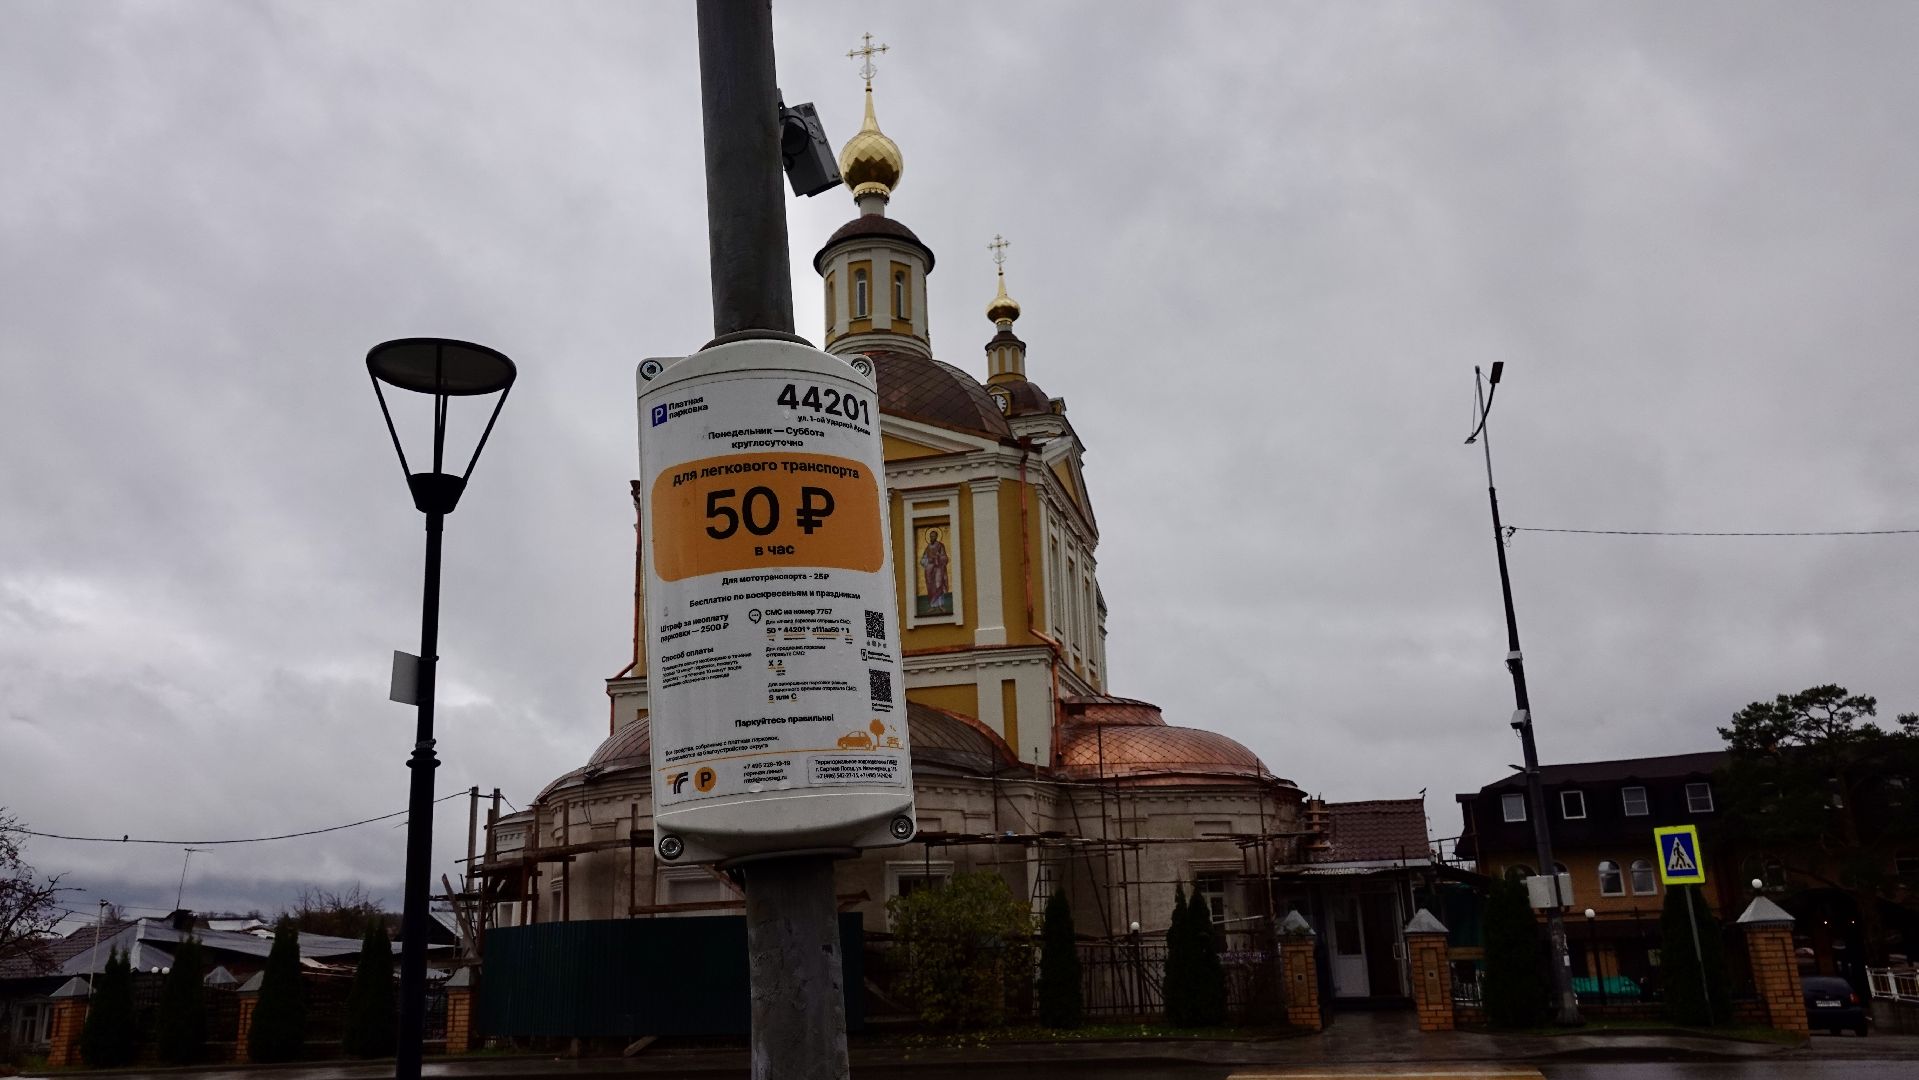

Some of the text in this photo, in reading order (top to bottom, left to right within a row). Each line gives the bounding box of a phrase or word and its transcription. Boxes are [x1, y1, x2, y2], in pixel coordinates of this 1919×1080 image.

[668, 396, 704, 411] Платная
[669, 403, 709, 420] парковка
[777, 383, 871, 426] 44201
[797, 414, 809, 423] ул.
[826, 416, 853, 430] Ударной
[708, 428, 772, 440] Понедельник
[785, 427, 825, 438] Суббота
[731, 439, 804, 450] круглосуточно
[673, 461, 860, 487] для легкового транспорта
[705, 486, 780, 540] 50
[754, 544, 796, 556] в час
[722, 577, 738, 586] Для
[740, 573, 807, 583] мототранспорта
[689, 594, 732, 608] Бесплатно
[745, 590, 808, 600] воскресеньям
[816, 590, 861, 600] праздникам
[660, 622, 683, 633] Штраф
[692, 614, 729, 626] неоплату
[660, 629, 691, 643] парковки
[701, 623, 721, 633] 2500
[661, 647, 714, 664] Способ оплаты
[735, 714, 834, 728] Паркуйтесь правильно!
